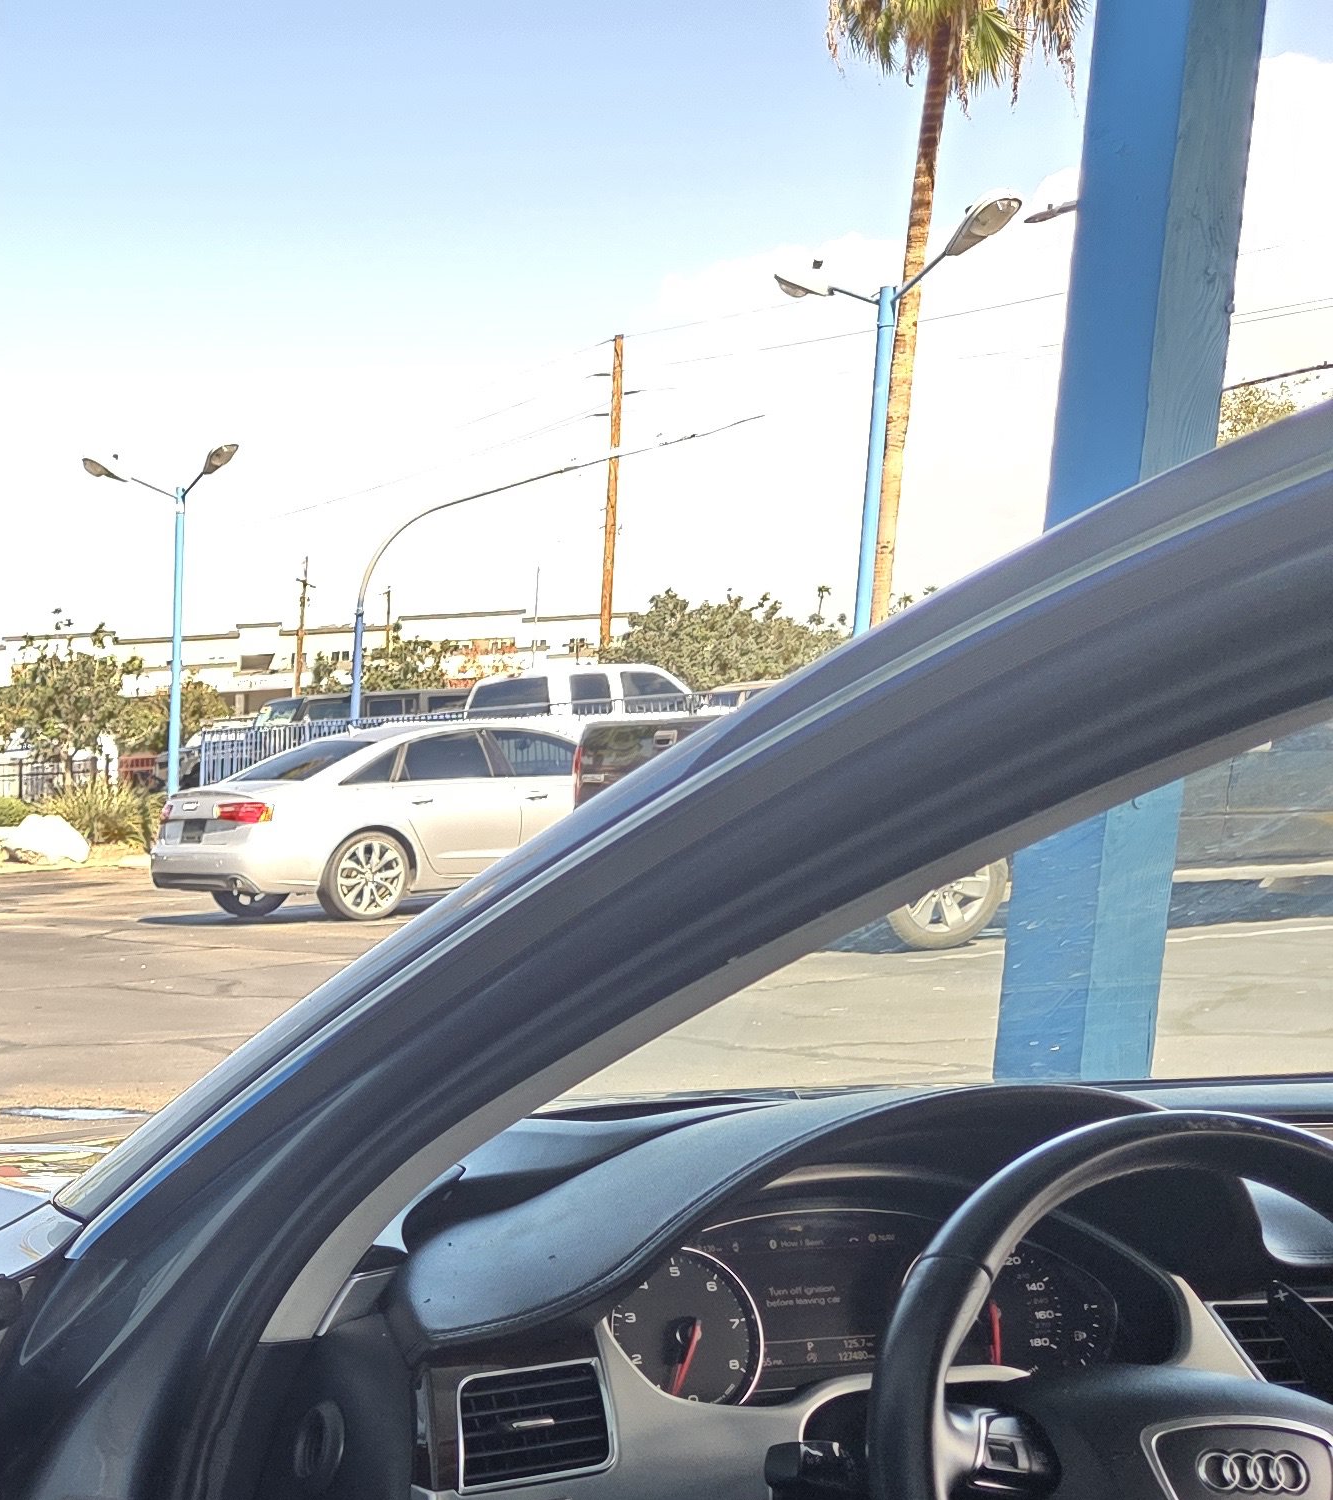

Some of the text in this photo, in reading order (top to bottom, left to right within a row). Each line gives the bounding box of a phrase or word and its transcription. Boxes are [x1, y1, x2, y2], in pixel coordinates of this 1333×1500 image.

[1005, 1256, 1021, 1266] 20
[670, 1267, 680, 1277] 5
[707, 1281, 718, 1292] 6
[768, 1287, 789, 1296] Turn
[790, 1286, 803, 1295] off
[1026, 1281, 1046, 1292] 140
[766, 1299, 794, 1308] before
[796, 1297, 826, 1307] leaving
[625, 1313, 636, 1323] 3
[1035, 1310, 1055, 1319] 160
[729, 1318, 740, 1329] 7
[807, 1342, 814, 1351] P
[844, 1339, 866, 1349] 125.7
[1029, 1337, 1050, 1347] 180
[632, 1354, 642, 1365] 2
[729, 1360, 740, 1370] 8
